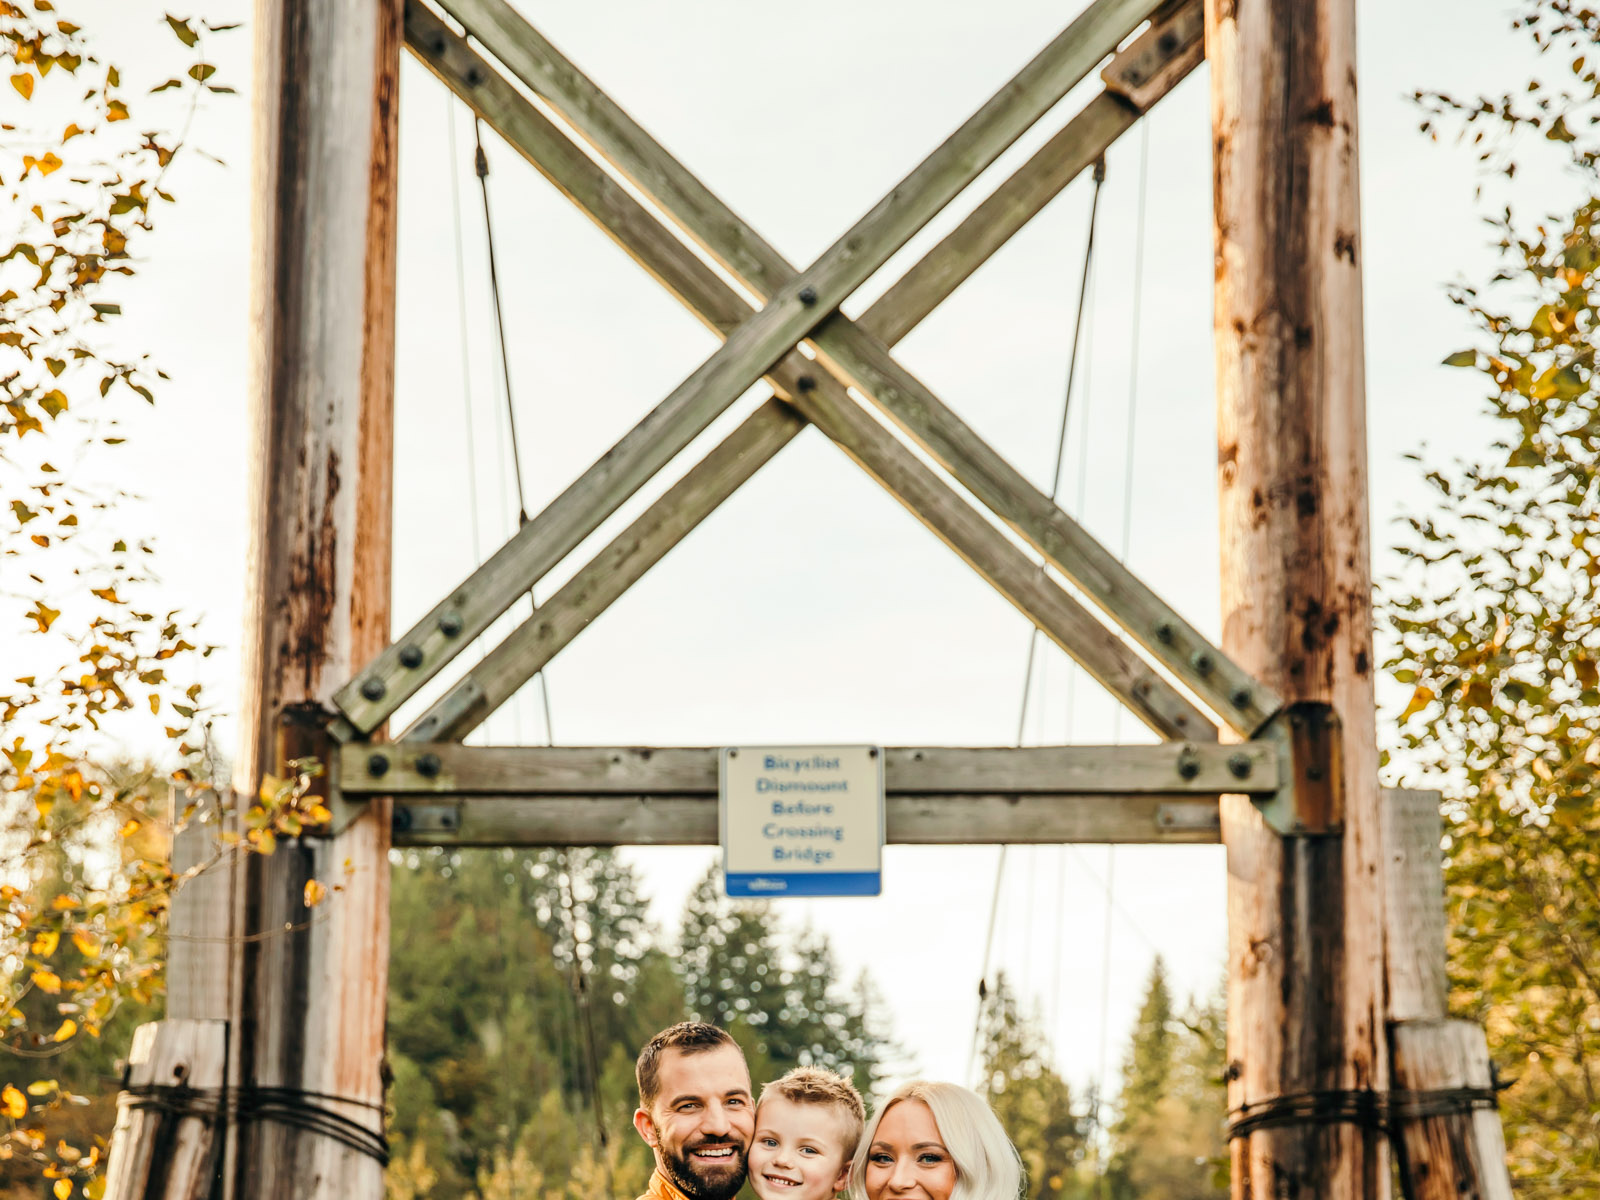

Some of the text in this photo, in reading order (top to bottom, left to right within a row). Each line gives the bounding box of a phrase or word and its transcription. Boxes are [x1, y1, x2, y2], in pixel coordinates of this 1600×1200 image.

[756, 778, 848, 793] Dismount
[772, 801, 833, 814] Before
[762, 823, 844, 840] Crossing
[773, 846, 833, 863] Bridge
